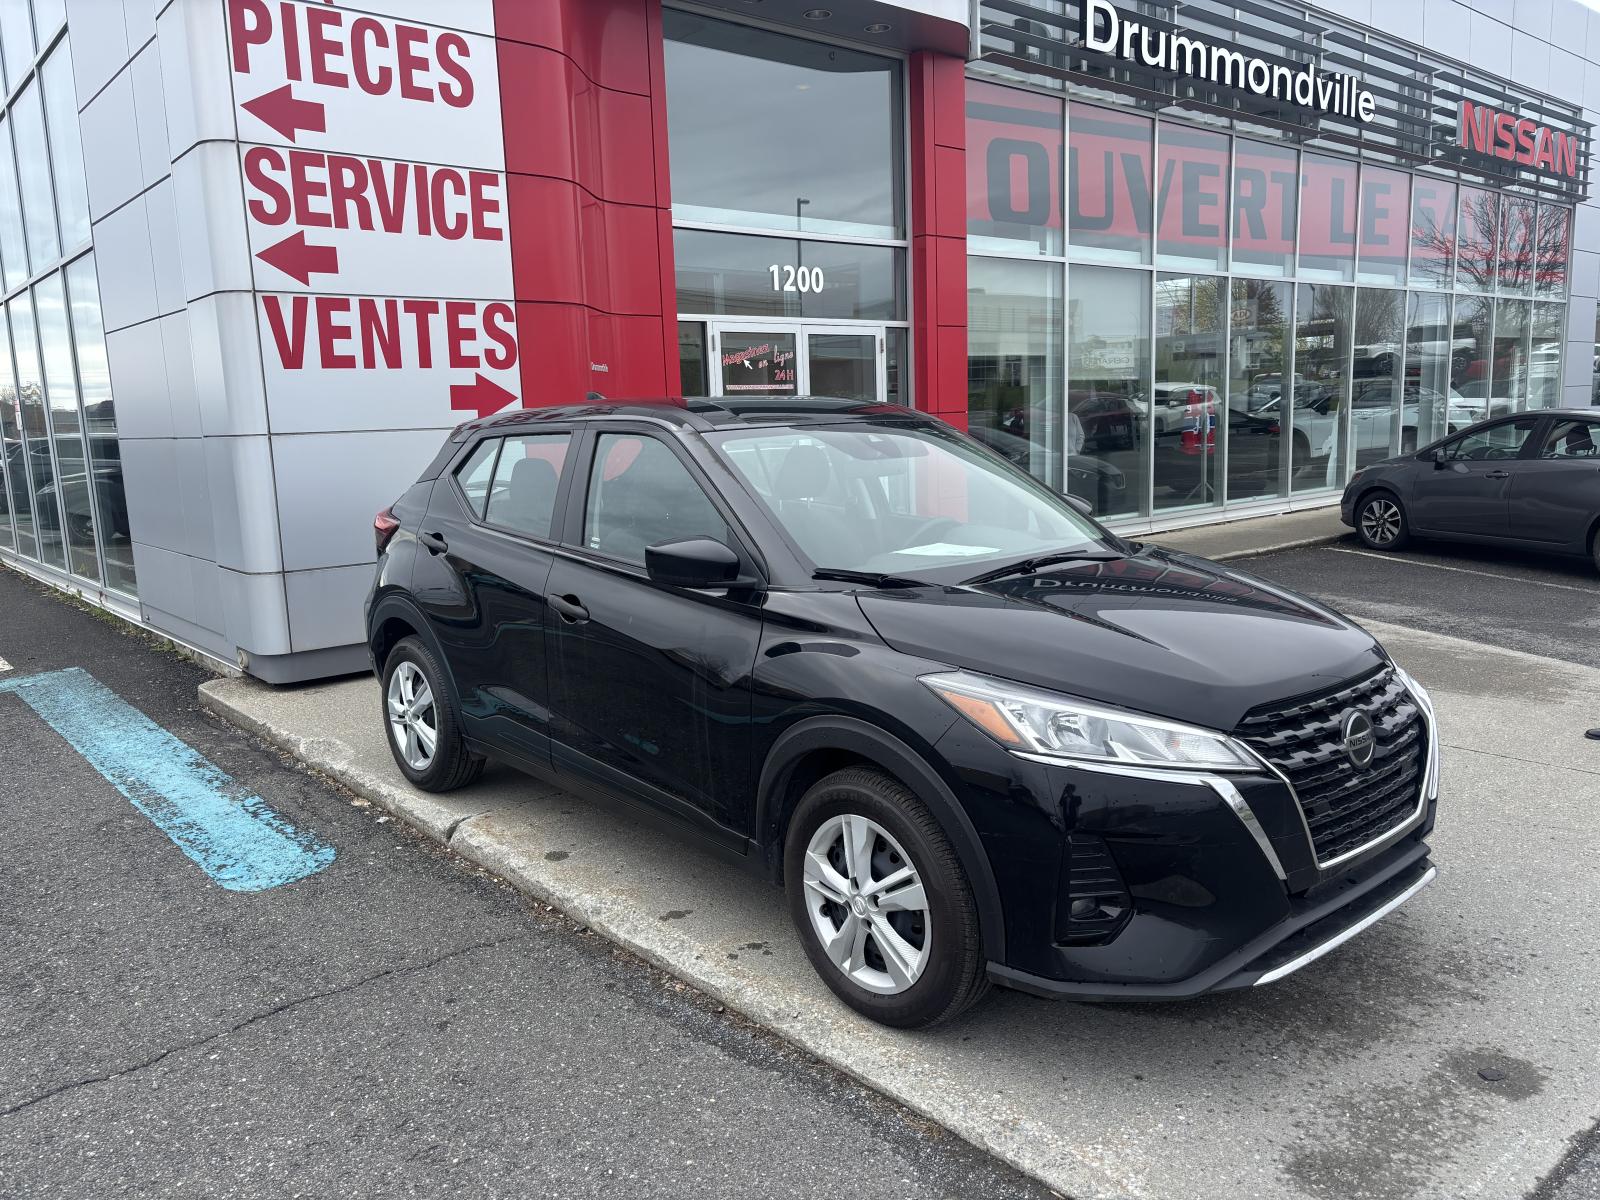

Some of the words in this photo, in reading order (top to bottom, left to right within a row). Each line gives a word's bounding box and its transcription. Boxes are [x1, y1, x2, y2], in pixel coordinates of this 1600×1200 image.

[228, 0, 475, 109] PIÈCES
[1084, 0, 1376, 123] Drummondville
[1461, 99, 1577, 177] NISSAN
[244, 147, 503, 241] SERVICE
[986, 137, 1308, 241] OUVERT
[1329, 176, 1391, 245] LE
[769, 264, 824, 293] 1200
[262, 295, 518, 370] VENTES
